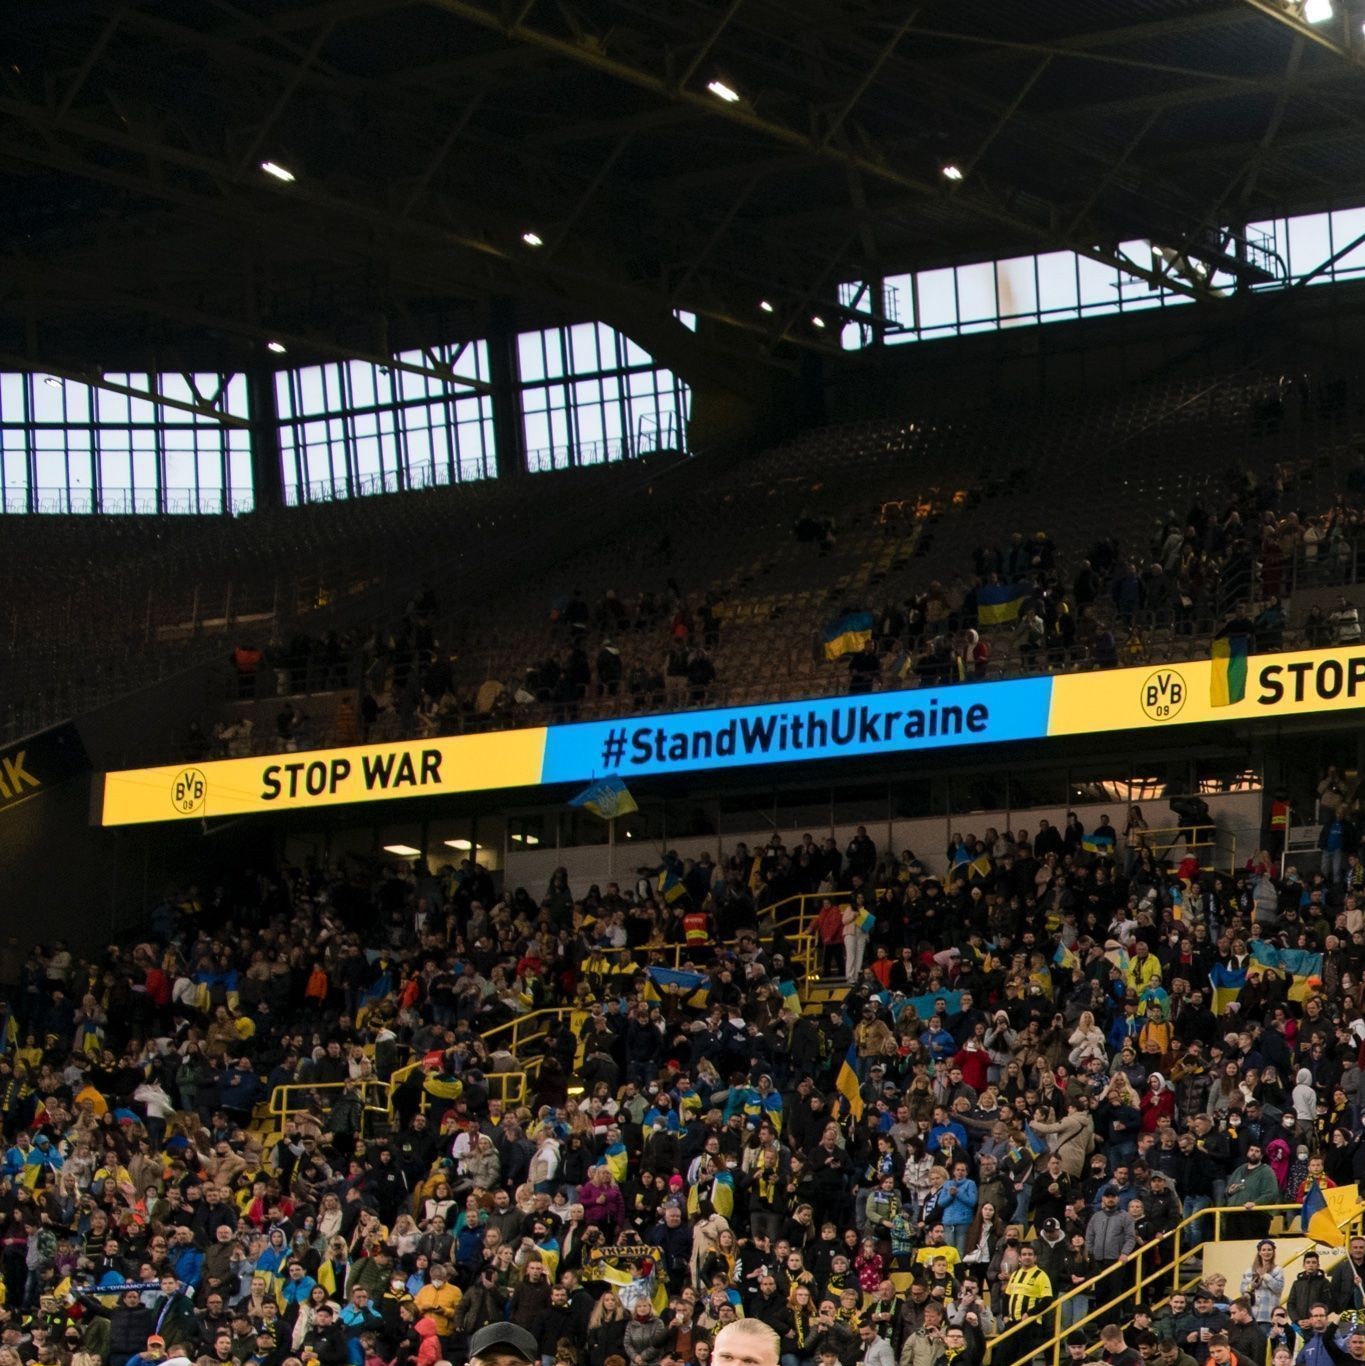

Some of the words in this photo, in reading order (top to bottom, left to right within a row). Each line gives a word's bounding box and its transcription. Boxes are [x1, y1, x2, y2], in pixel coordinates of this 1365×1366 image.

[1147, 674, 1182, 706] BVB
[1157, 706, 1169, 717] 09
[602, 699, 988, 767] #StandWithUkraine
[176, 772, 204, 801] BVB
[262, 759, 350, 801] STOP
[363, 750, 442, 789] WAR
[183, 801, 193, 811] 09
